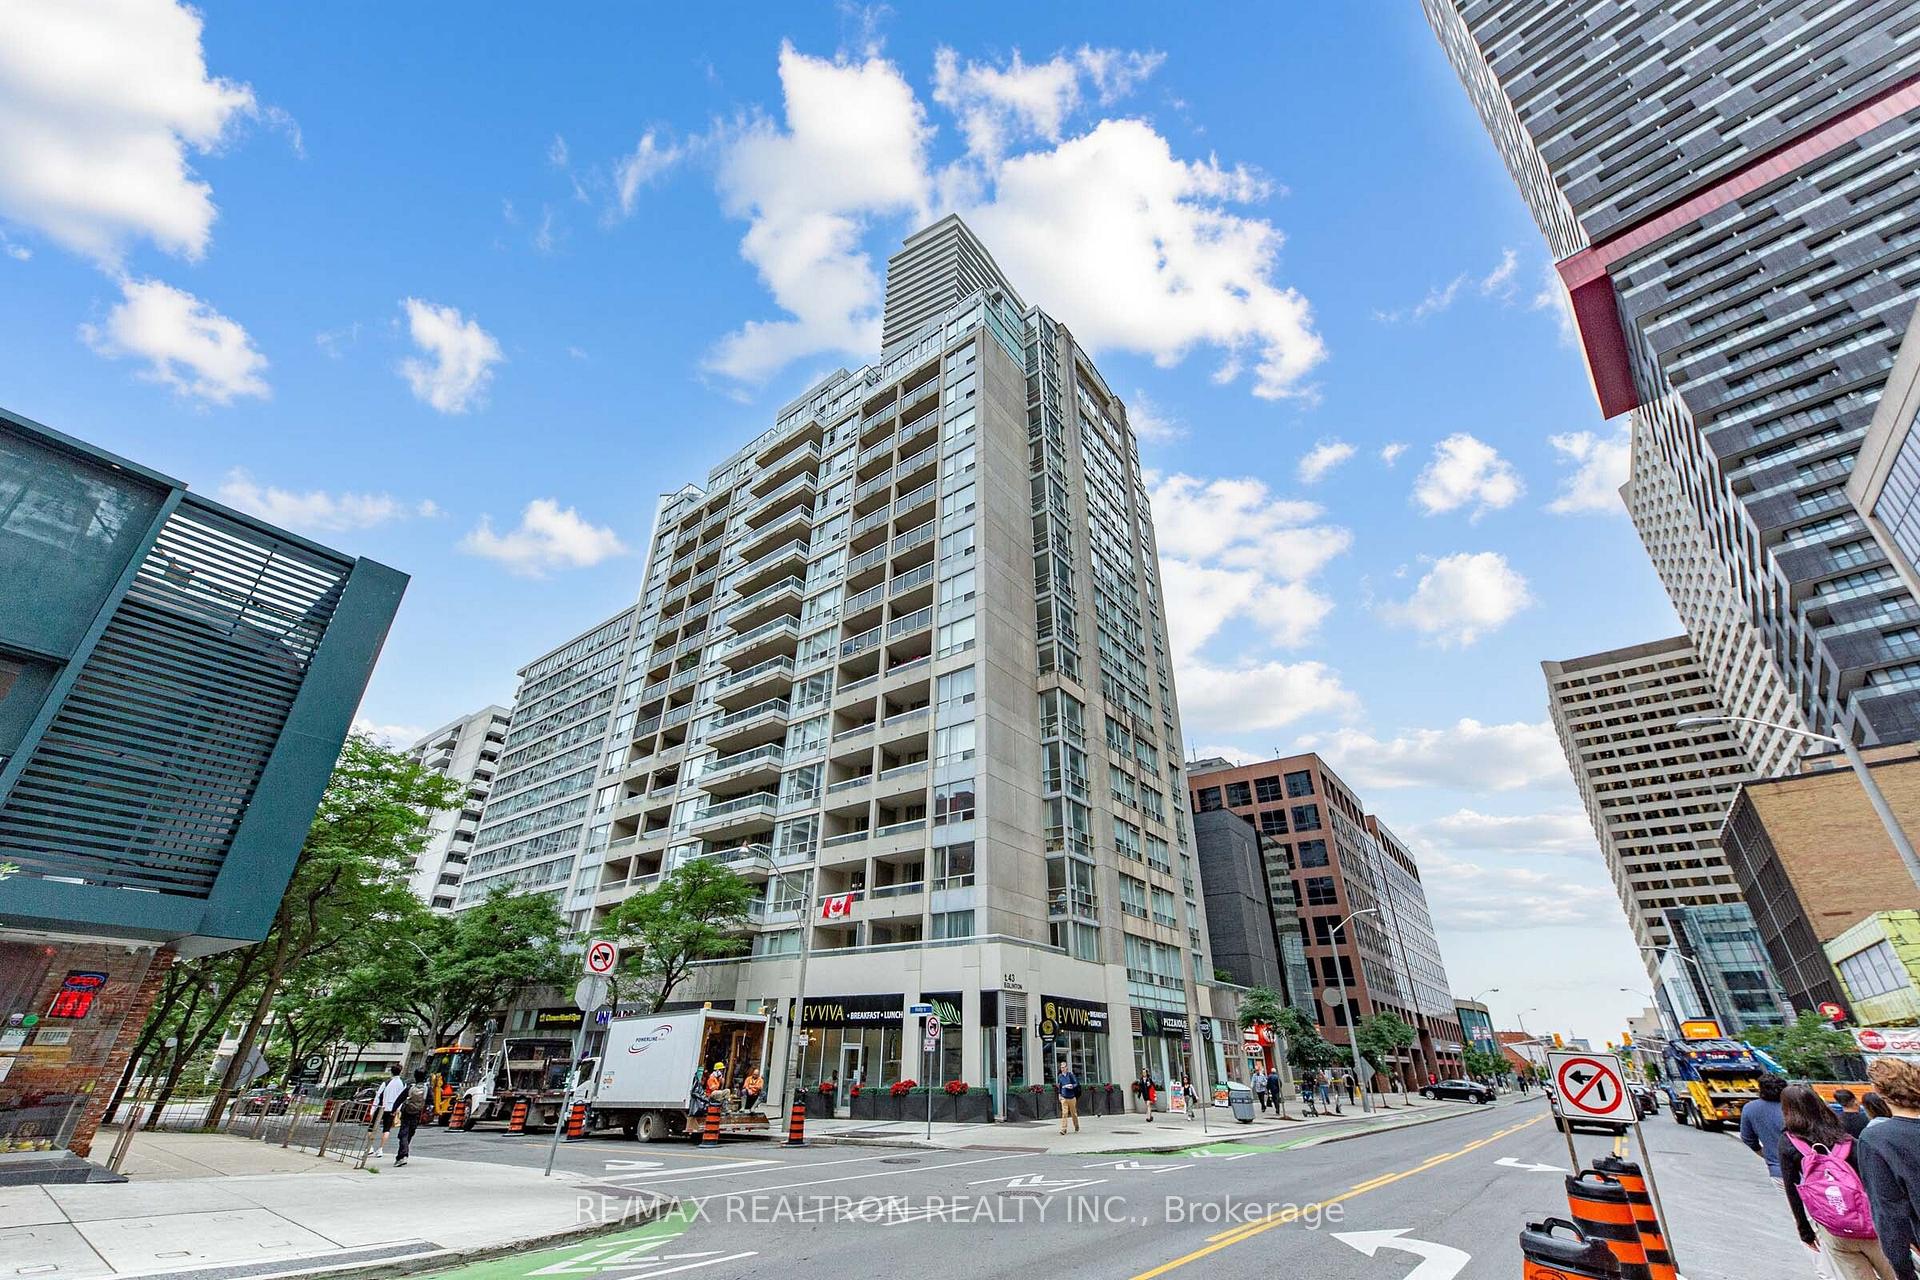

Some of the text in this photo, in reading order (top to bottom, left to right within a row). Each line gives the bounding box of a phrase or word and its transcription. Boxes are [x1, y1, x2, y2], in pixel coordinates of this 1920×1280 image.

[803, 1004, 904, 1022] EVVIVA BREAKFAST LUNCH
[1057, 1006, 1089, 1026] EVVIVA
[1891, 1041, 1920, 1050] OPE
